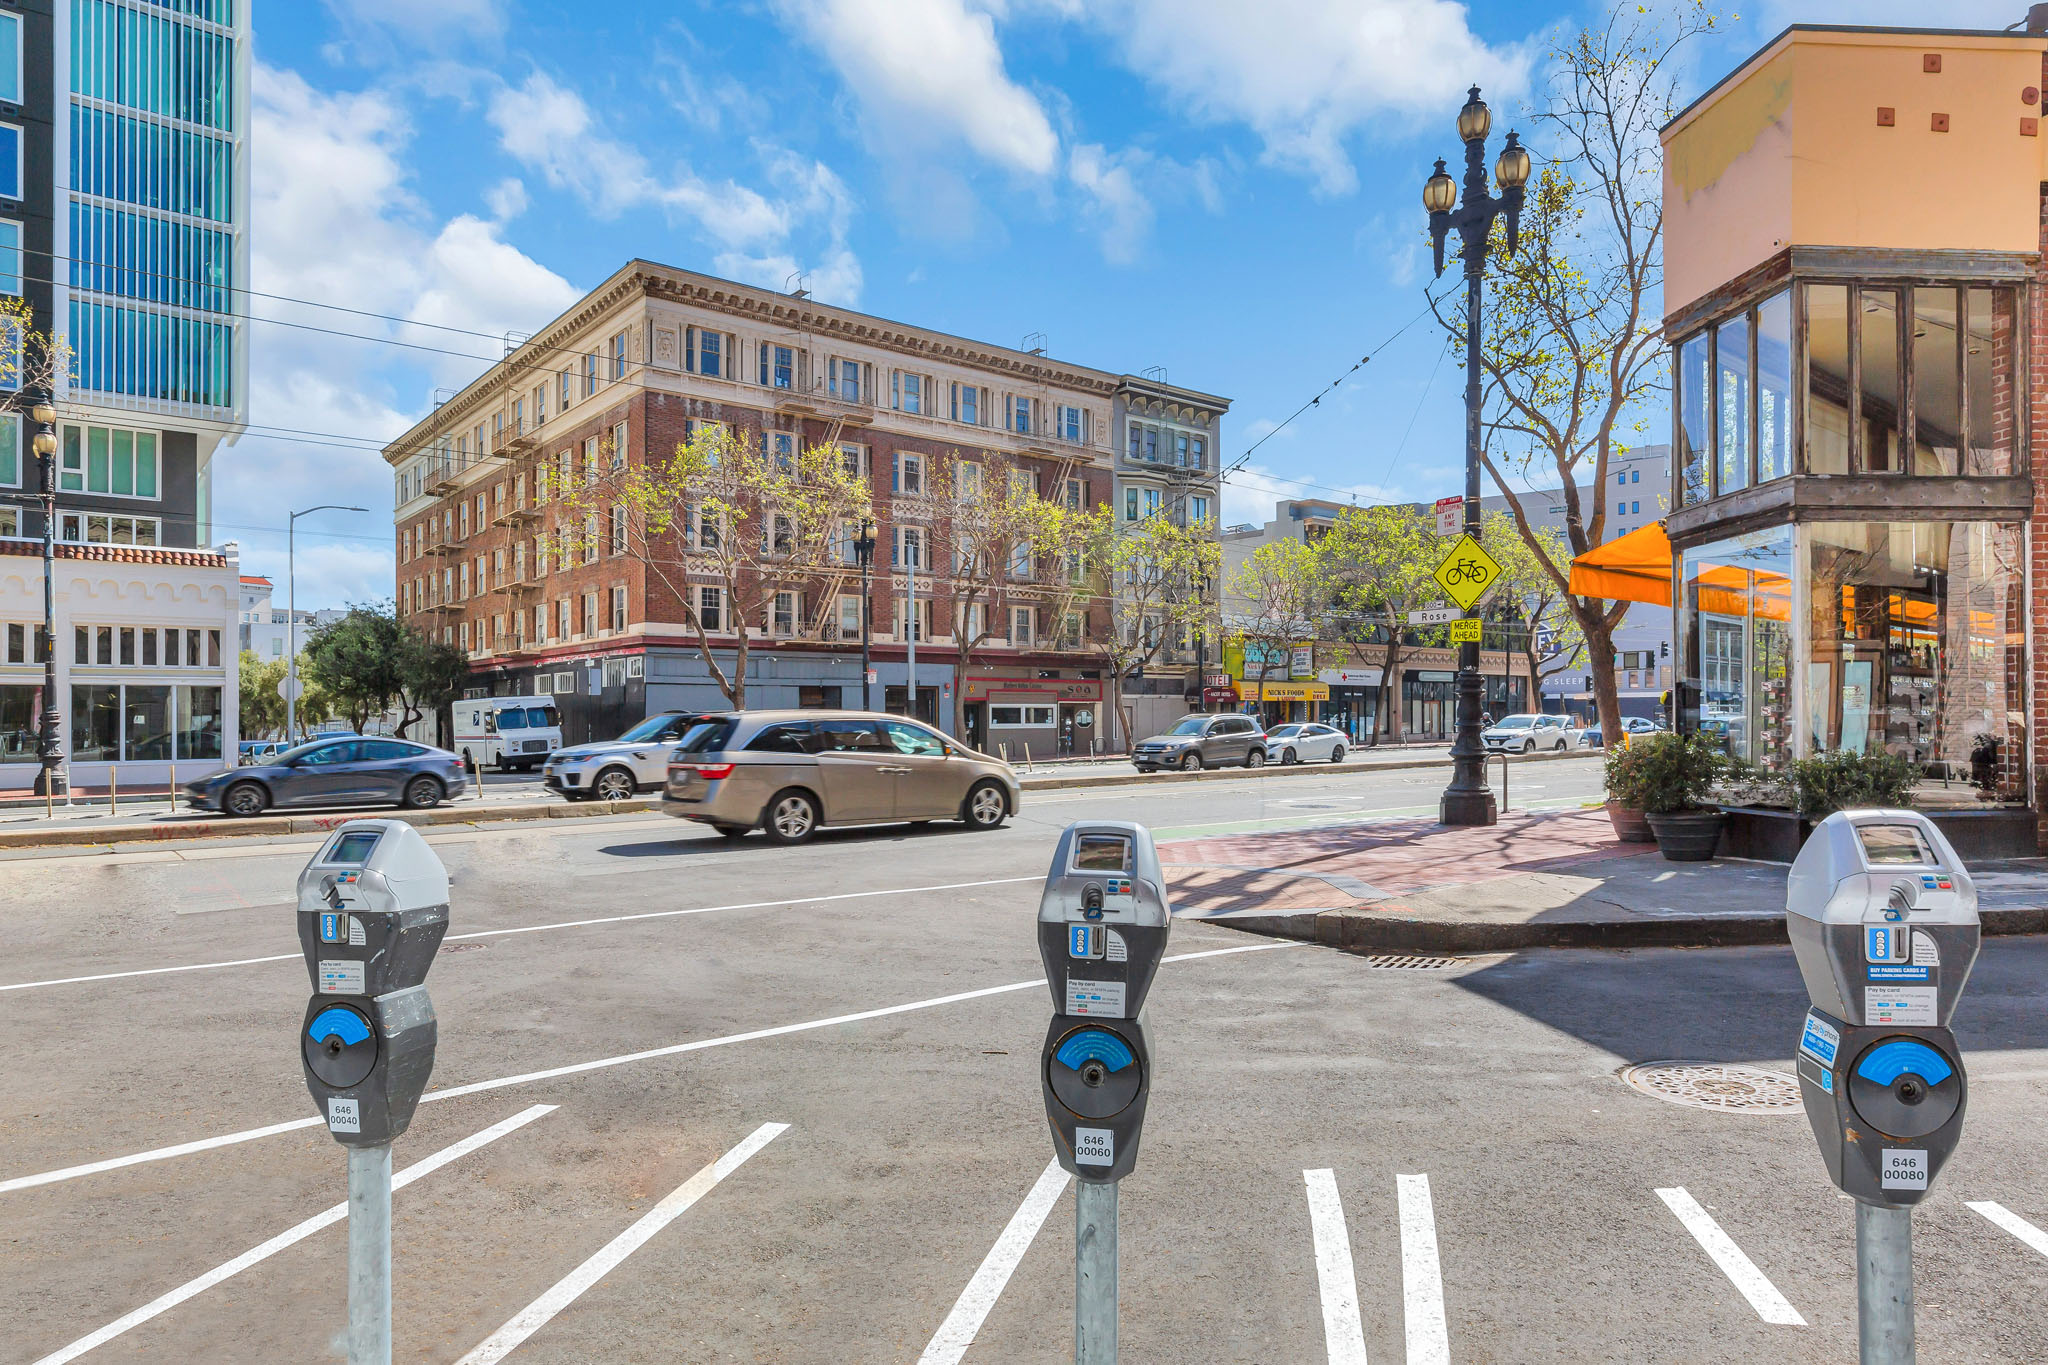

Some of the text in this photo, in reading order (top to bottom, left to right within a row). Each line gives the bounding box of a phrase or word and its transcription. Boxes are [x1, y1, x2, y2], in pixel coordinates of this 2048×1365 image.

[1444, 520, 1456, 528] TIME
[1421, 612, 1447, 622] Rose
[1454, 621, 1478, 630] MERGE
[1454, 631, 1479, 639] AHEAD
[1554, 677, 1584, 685] SLEEP
[335, 1105, 352, 1115] 646
[330, 1115, 358, 1125] 00040
[1084, 1135, 1104, 1146] 646
[1077, 1146, 1111, 1157] 00060
[1892, 1157, 1917, 1168] 646
[1883, 1169, 1925, 1181] 00080
